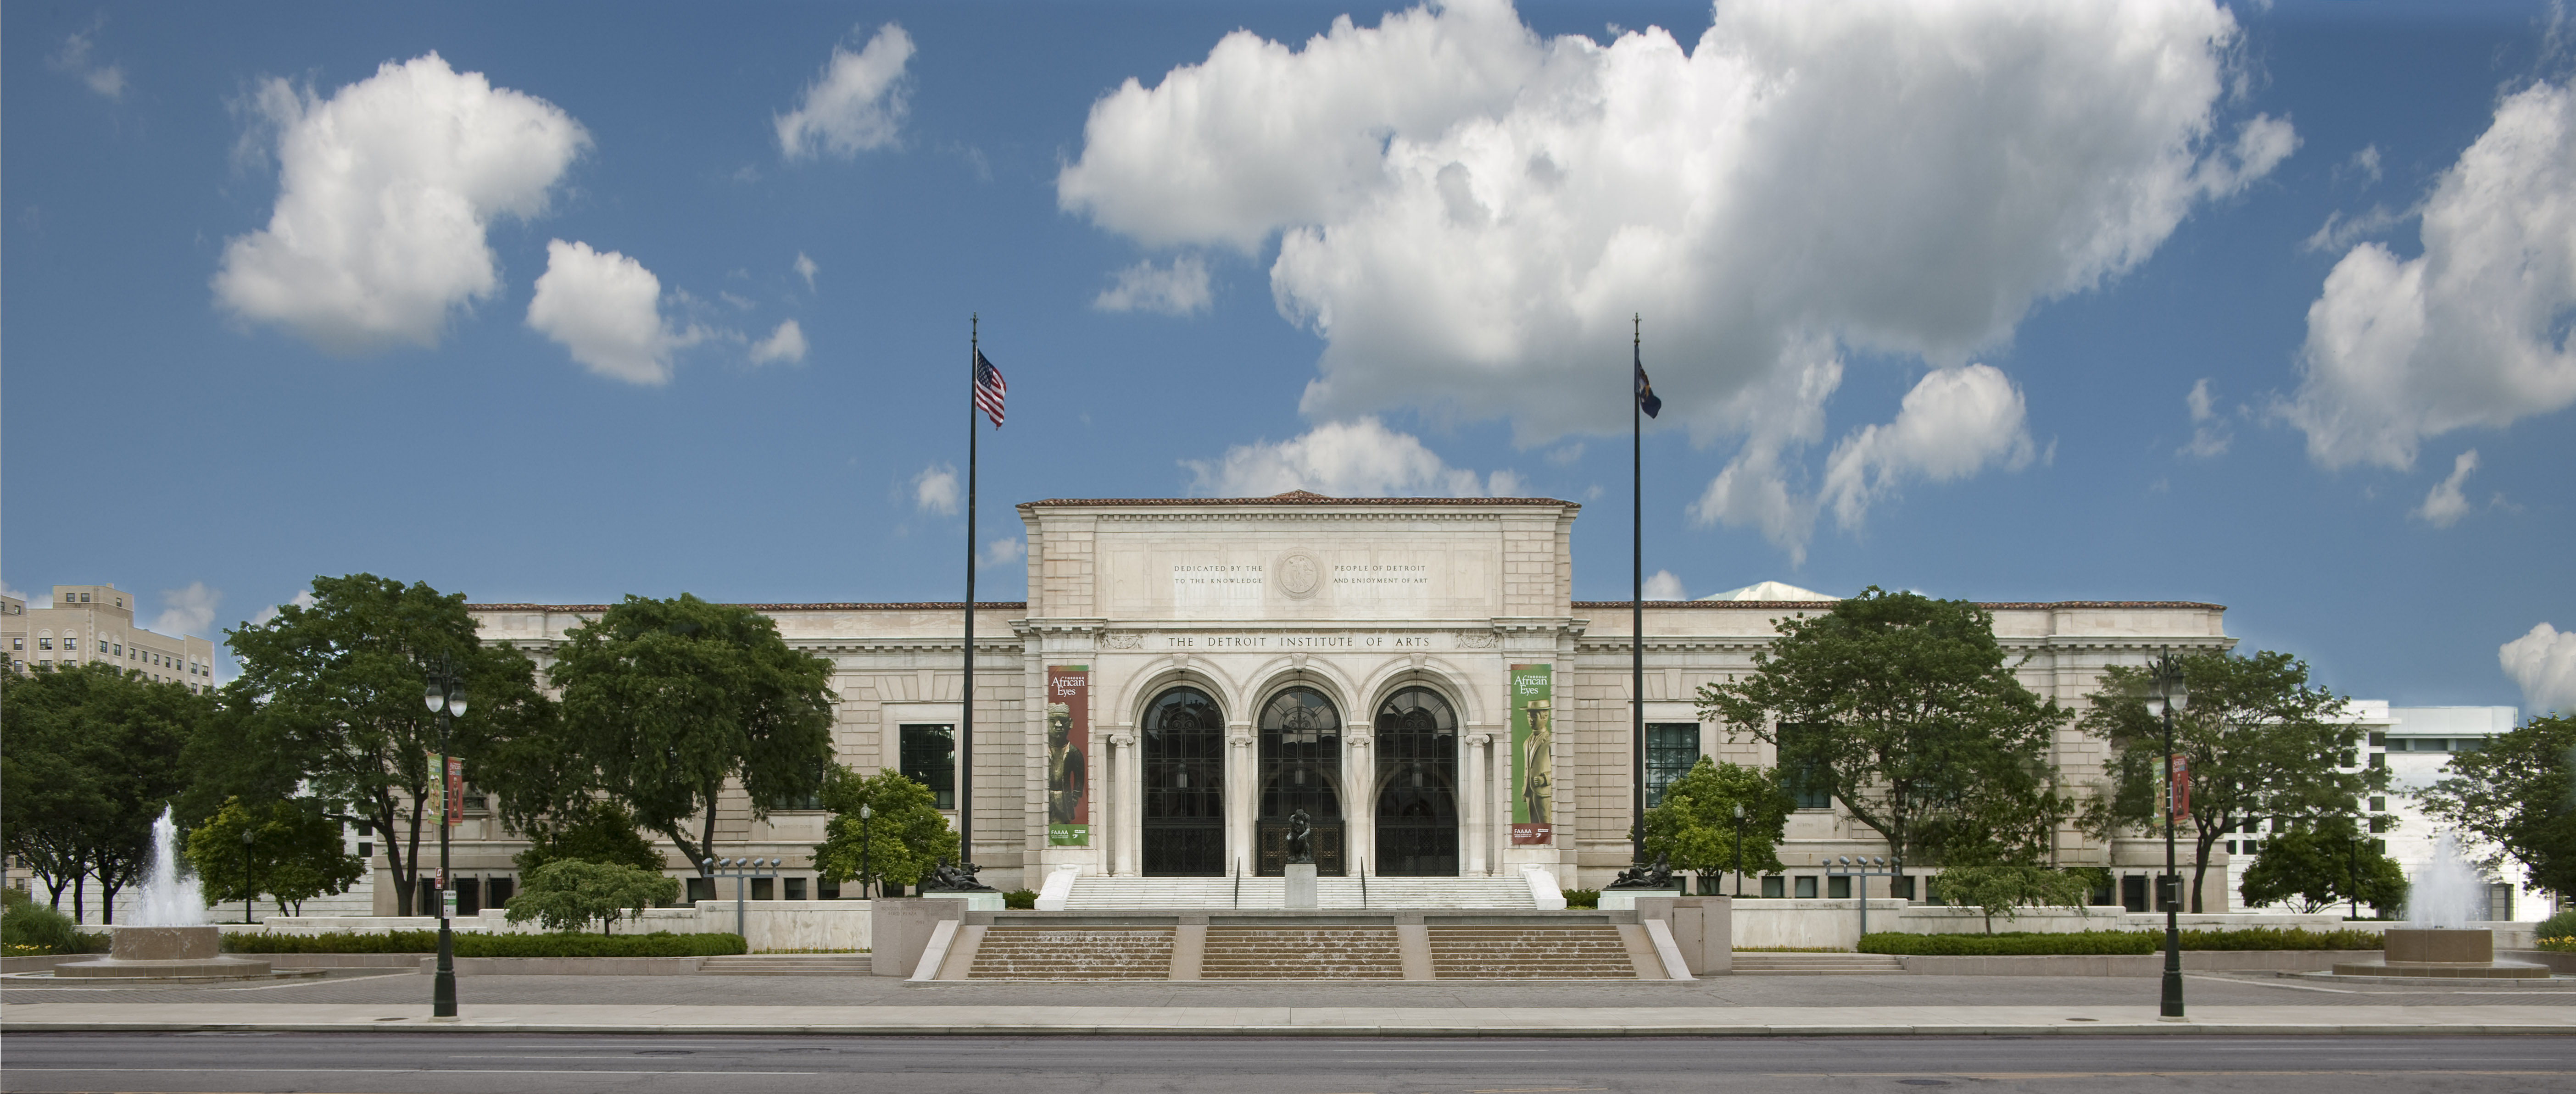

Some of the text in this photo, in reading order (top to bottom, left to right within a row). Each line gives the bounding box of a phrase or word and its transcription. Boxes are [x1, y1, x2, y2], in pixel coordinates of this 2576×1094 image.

[1168, 637, 1429, 646] THE DETROIT INSTITUTE OF ARTS
[1051, 676, 1085, 686] African
[1514, 675, 1547, 685] African
[1057, 686, 1076, 697] Eyes
[1520, 685, 1539, 696] Eyes
